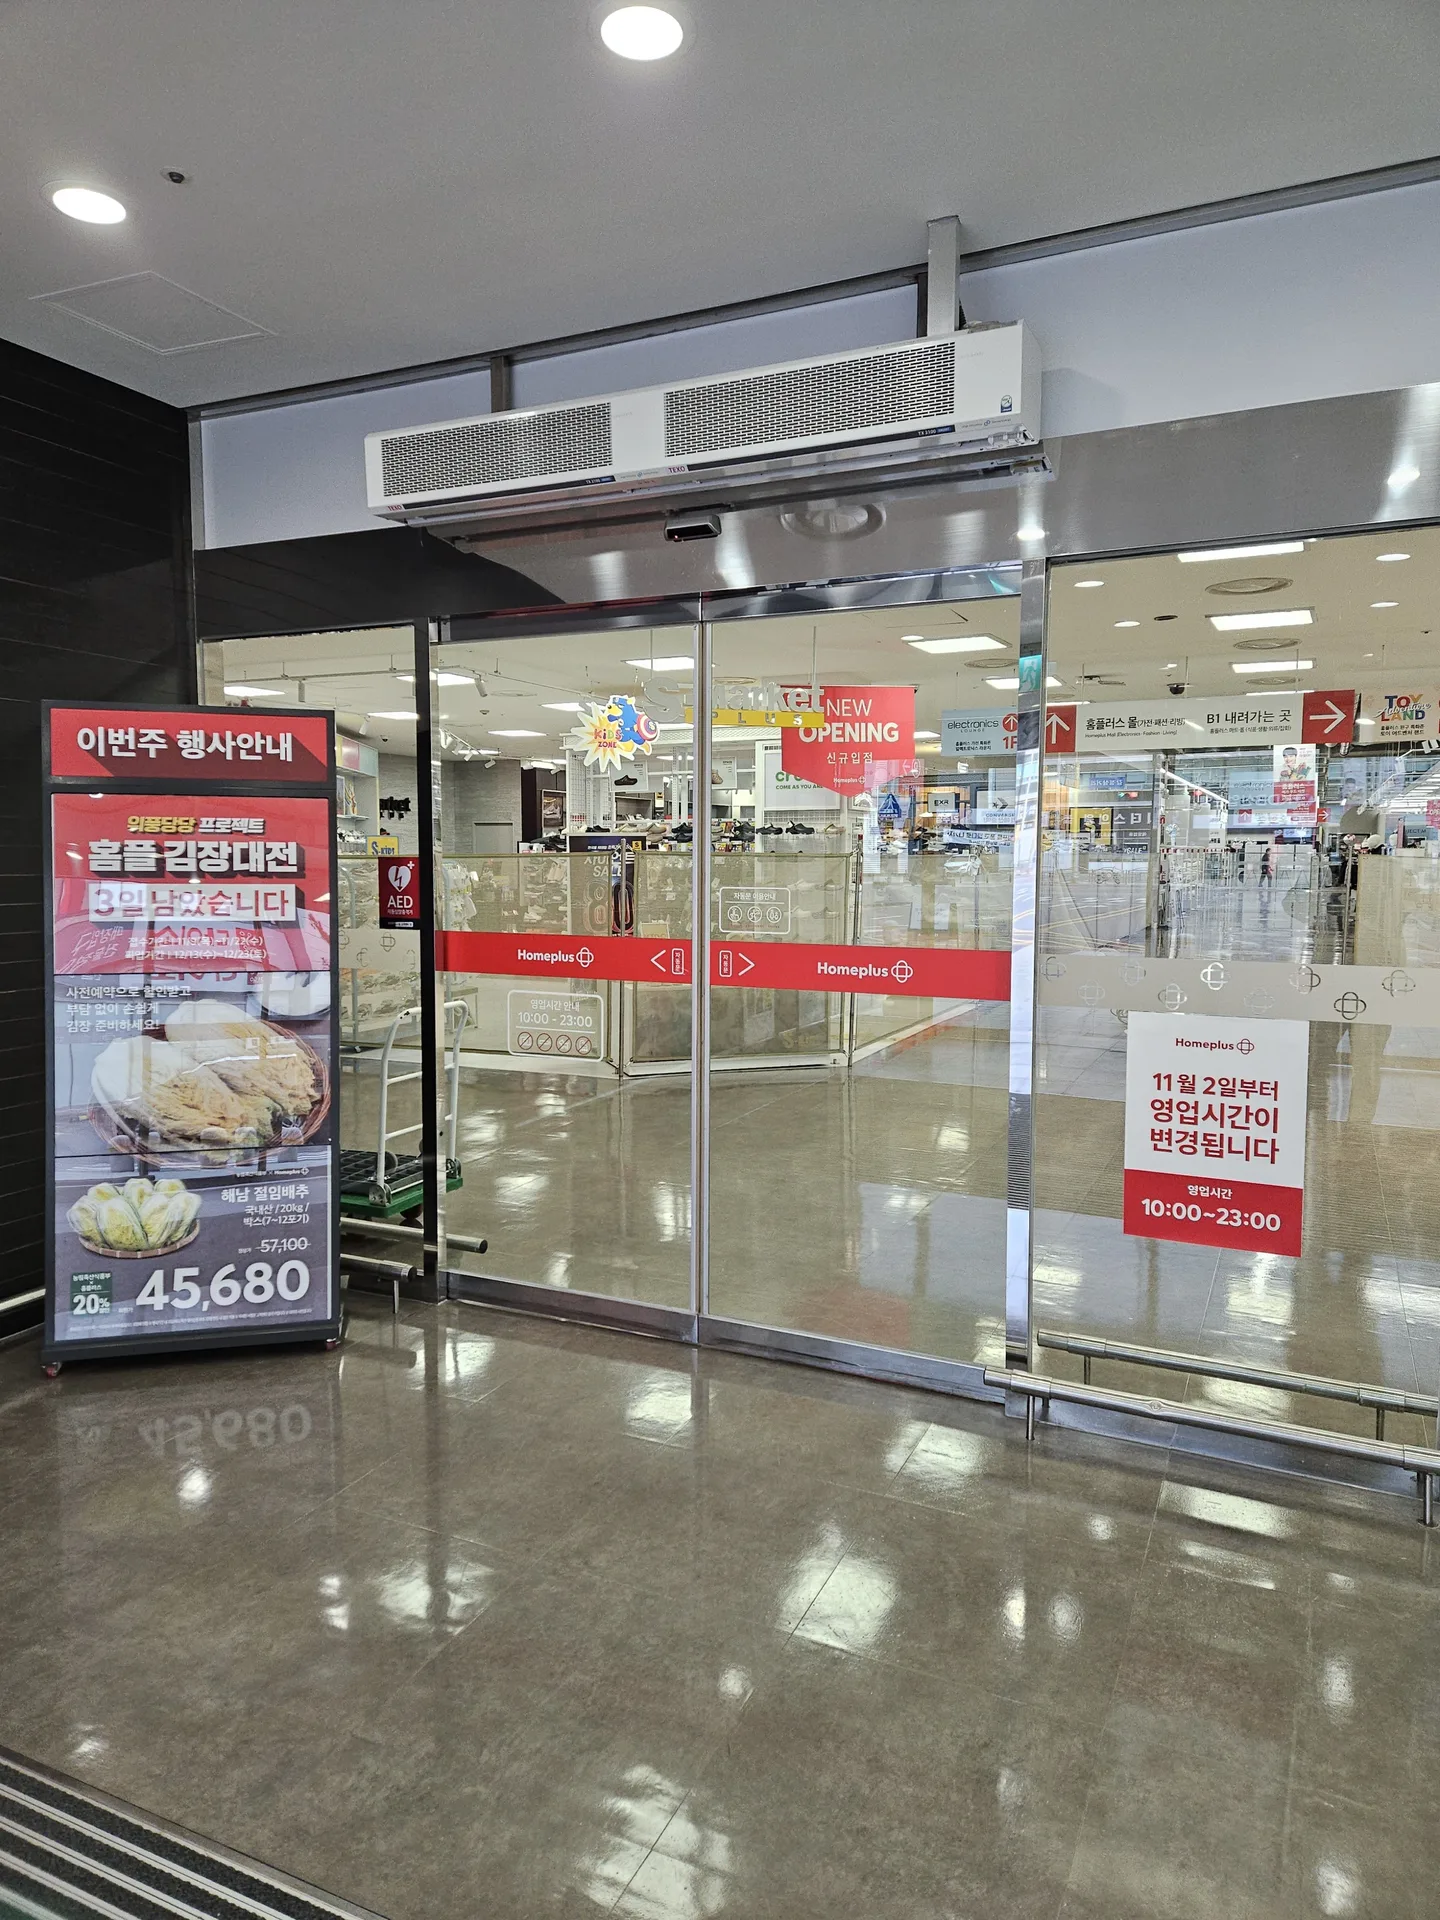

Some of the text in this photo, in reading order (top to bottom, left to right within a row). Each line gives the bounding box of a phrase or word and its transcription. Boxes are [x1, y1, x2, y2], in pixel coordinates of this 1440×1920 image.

[827, 698, 872, 717] NEW
[1381, 709, 1425, 721] LAND
[1206, 709, 1292, 724] B1 내려가는 곳
[947, 720, 999, 730] electronics
[1086, 718, 1125, 731] 홈플러스
[799, 723, 899, 743] OPENING
[77, 726, 293, 762] 이번주 행사안내
[598, 741, 617, 749] ZONE
[1002, 736, 1018, 749] 1F
[827, 752, 873, 764] 신규입점
[127, 816, 265, 834] 위풍당당 프로젝트
[88, 839, 298, 873] 홈플 김장대전
[94, 889, 289, 917] 3일 남았습니다
[388, 895, 414, 908] AED
[517, 949, 575, 963] Homeplus
[817, 961, 889, 979] Homeplus
[66, 987, 140, 998] 사전예약으로
[66, 1003, 158, 1016] 부담 없이 손쉽게
[530, 999, 580, 1012] 영업시간 안내
[67, 1019, 159, 1033] 김장 준비하세요!
[517, 1012, 549, 1024] 10:00
[559, 1014, 593, 1027] 23:00
[1175, 1038, 1234, 1051] Homeplus
[1153, 1073, 1279, 1101] 11월 2일부터
[1150, 1099, 1279, 1134] 영업시간이
[1150, 1128, 1280, 1165] 변경됩니다
[221, 1184, 309, 1203] 해남 절임배추
[1187, 1185, 1233, 1200] 영업시간
[245, 1205, 274, 1215] 국내산
[1141, 1199, 1281, 1232] 10:00~23:00
[243, 1214, 309, 1227] 박스(7~12포기)
[260, 1237, 308, 1254] 57,100
[136, 1259, 310, 1312] 45,680
[73, 1294, 110, 1315] 20%
